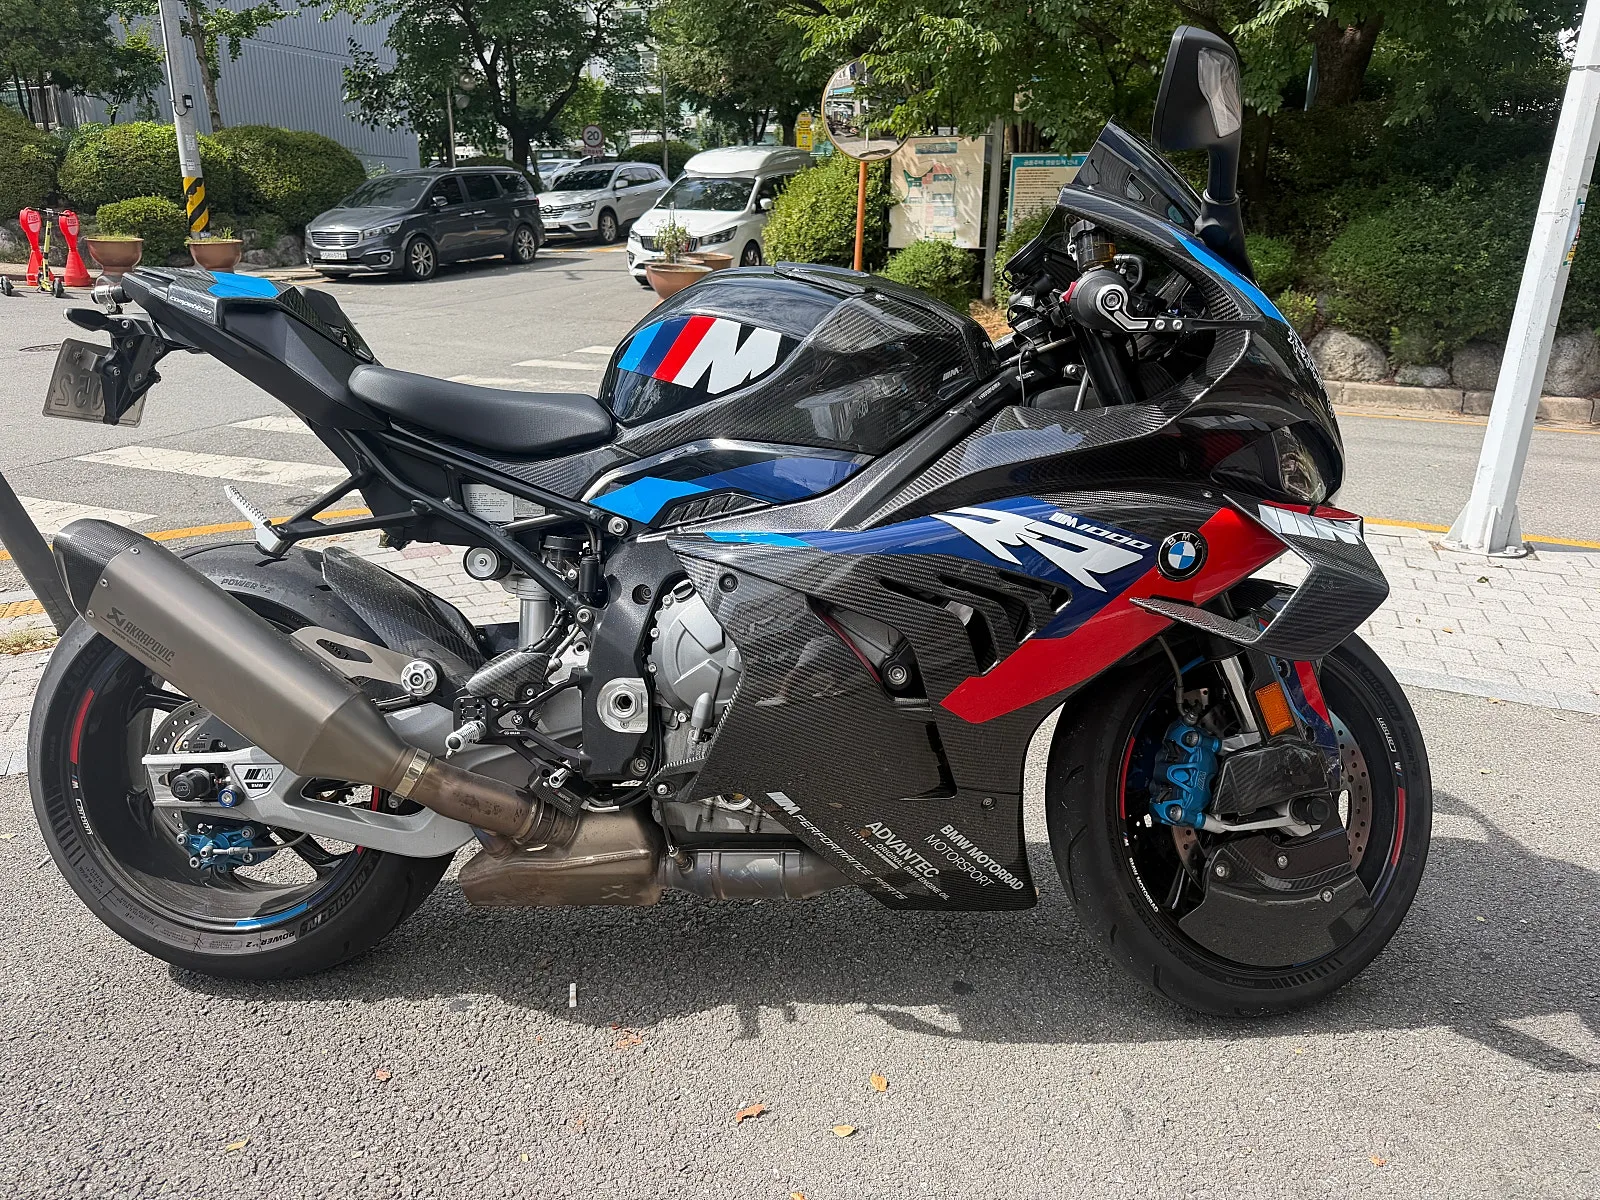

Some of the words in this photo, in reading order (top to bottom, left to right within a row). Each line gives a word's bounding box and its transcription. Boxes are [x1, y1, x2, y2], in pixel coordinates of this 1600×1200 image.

[586, 130, 600, 141] 20
[169, 296, 212, 315] competition
[672, 317, 782, 395] M
[220, 578, 258, 590] POWER
[792, 814, 874, 876] PERFORMANCE
[871, 876, 908, 900] PARTS
[865, 821, 940, 878] ADVANTEC
[875, 843, 904, 868] ORIGINAL
[903, 865, 920, 879] BMW
[917, 875, 942, 894] ENGINE
[924, 833, 995, 887] MOTORSPORT
[939, 824, 974, 850] BMW
[969, 847, 1024, 891] MOTORRAD
[1128, 857, 1139, 876] BMW
[1136, 876, 1159, 913] MOTORRAD
[260, 930, 296, 946] POWER
